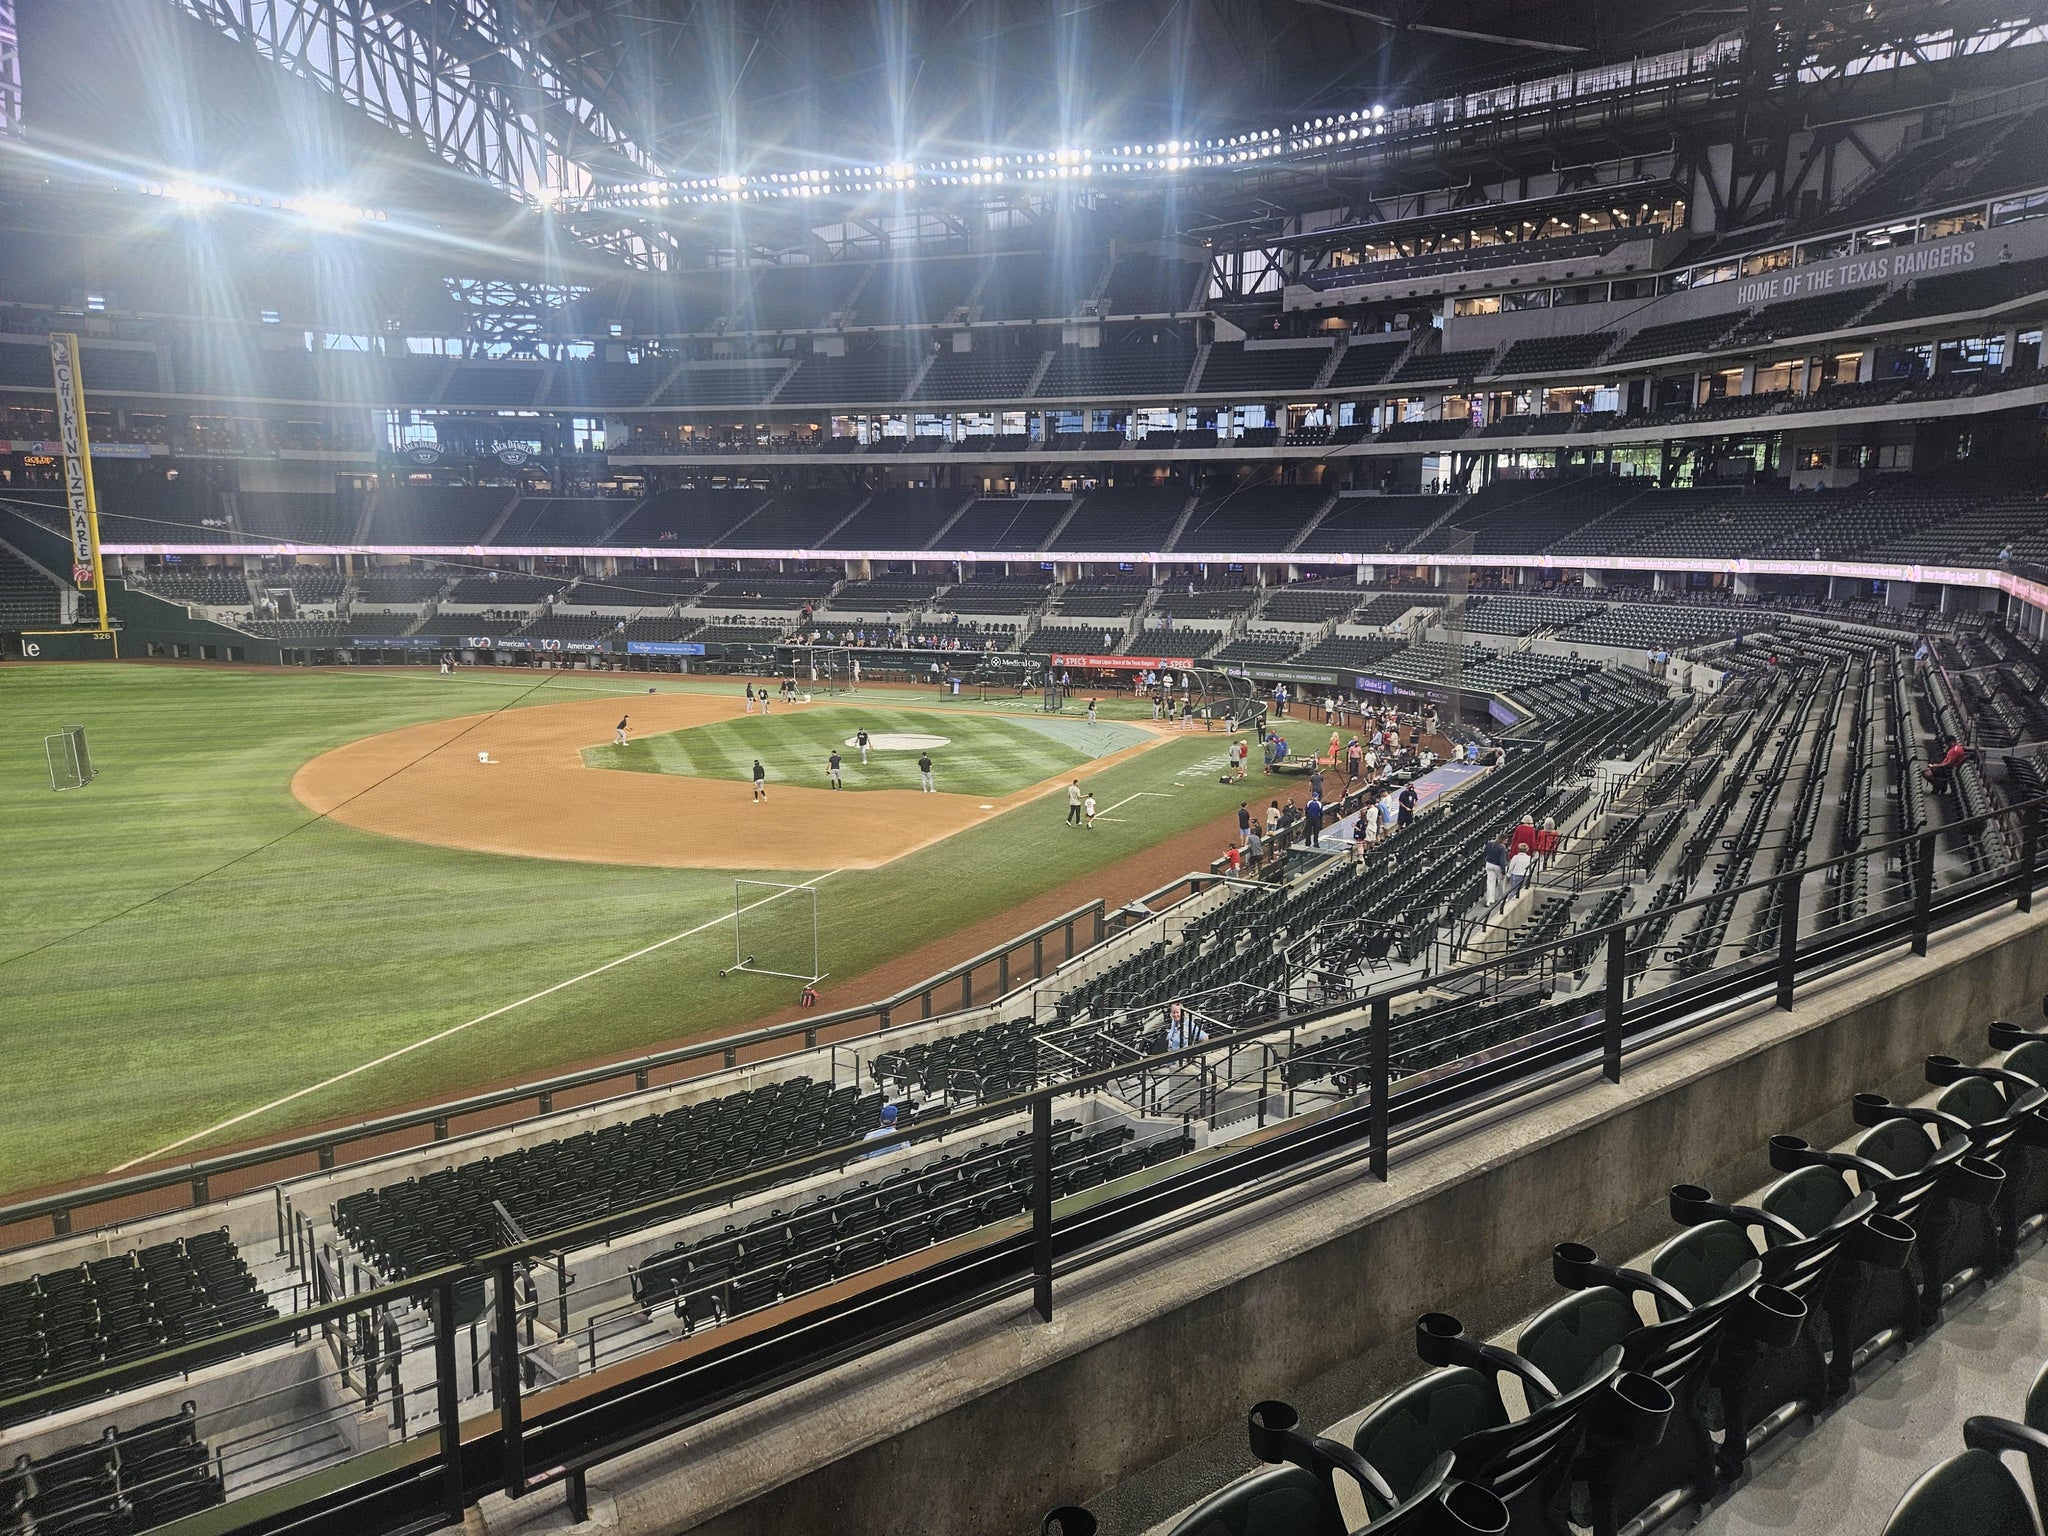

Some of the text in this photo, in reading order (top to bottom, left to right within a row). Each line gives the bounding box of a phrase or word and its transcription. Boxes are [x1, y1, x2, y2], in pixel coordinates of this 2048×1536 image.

[1737, 241, 1976, 304] HOME OF THE TEXAS RANGERS
[403, 442, 419, 453] JACK
[491, 443, 507, 454] JACK
[57, 368, 89, 559] CHIKIN IZ FARE
[1754, 562, 1769, 570] Now
[1769, 563, 1798, 573] Enrolling
[1799, 564, 1817, 574] Ages
[498, 640, 525, 648] American
[567, 642, 595, 650] American
[1002, 659, 1042, 668] Medical City
[1065, 656, 1086, 666] SPEC'S
[1170, 659, 1191, 669] SPEC'S
[1364, 680, 1386, 690] Globe Lie
[1398, 688, 1409, 696] Globe
